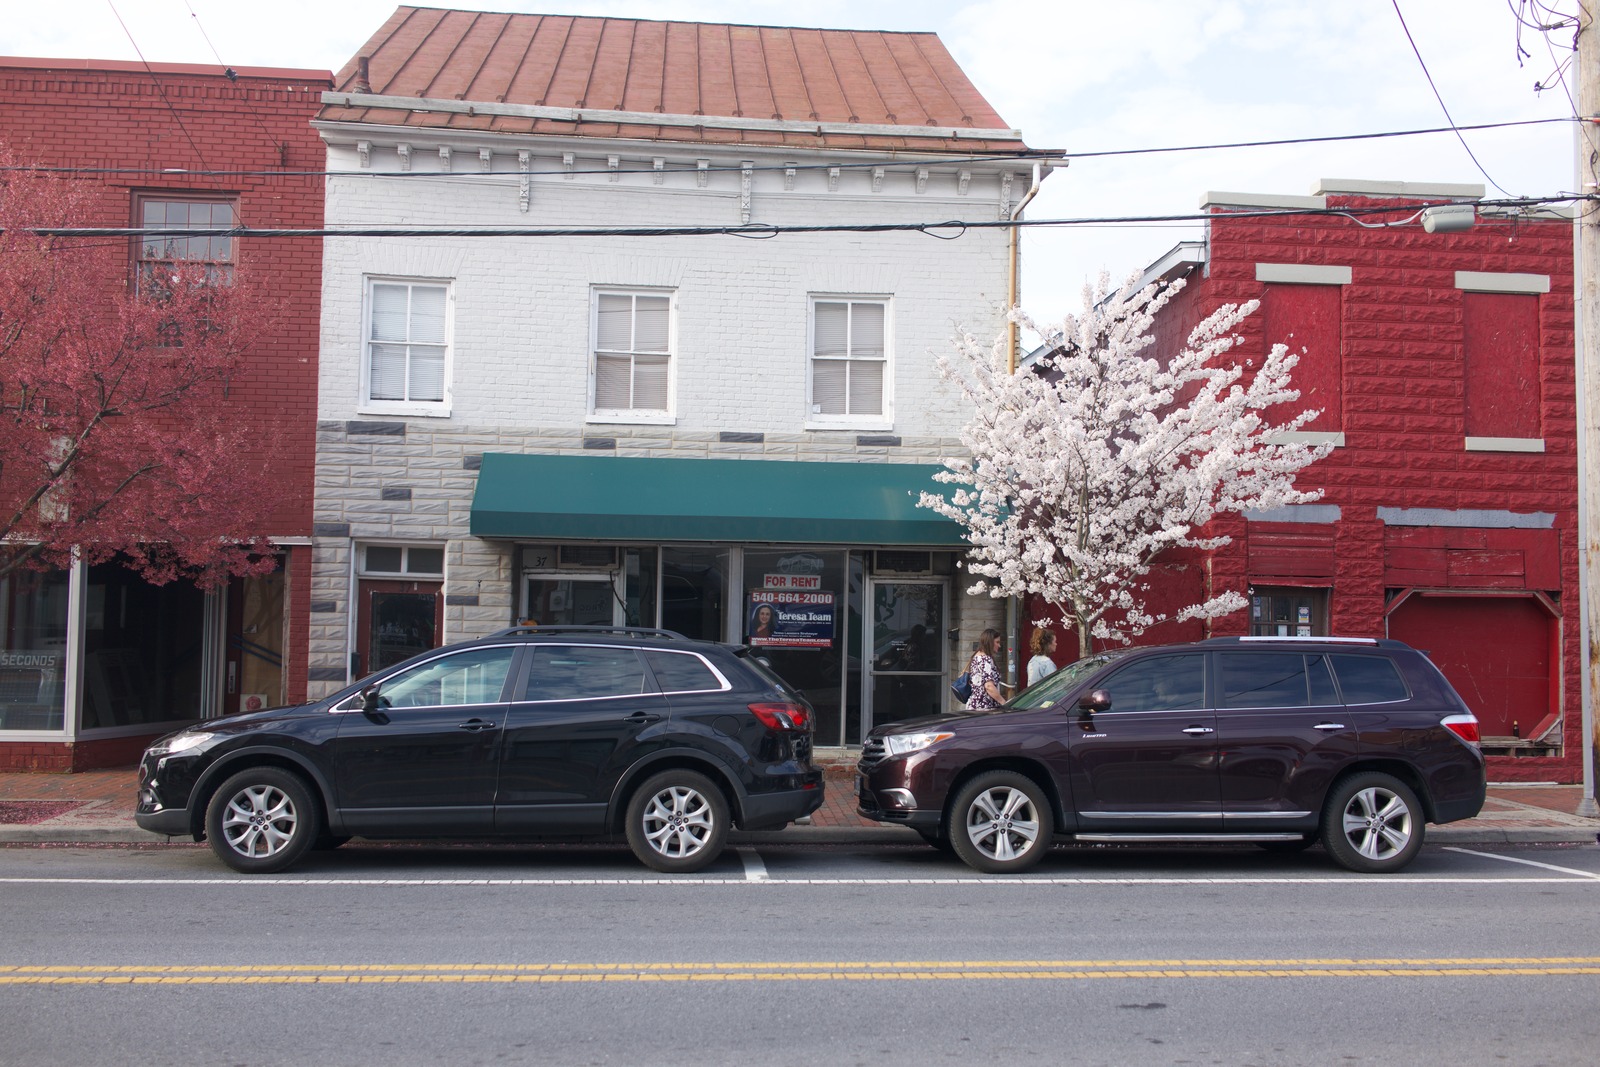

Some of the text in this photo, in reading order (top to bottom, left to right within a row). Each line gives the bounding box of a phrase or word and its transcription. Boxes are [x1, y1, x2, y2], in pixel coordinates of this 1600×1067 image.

[535, 556, 547, 567] 37
[765, 576, 819, 588] FOR RENT
[753, 592, 832, 604] 540-664-2000
[778, 611, 832, 622] Teresa Team
[1, 654, 56, 666] SECONDS
